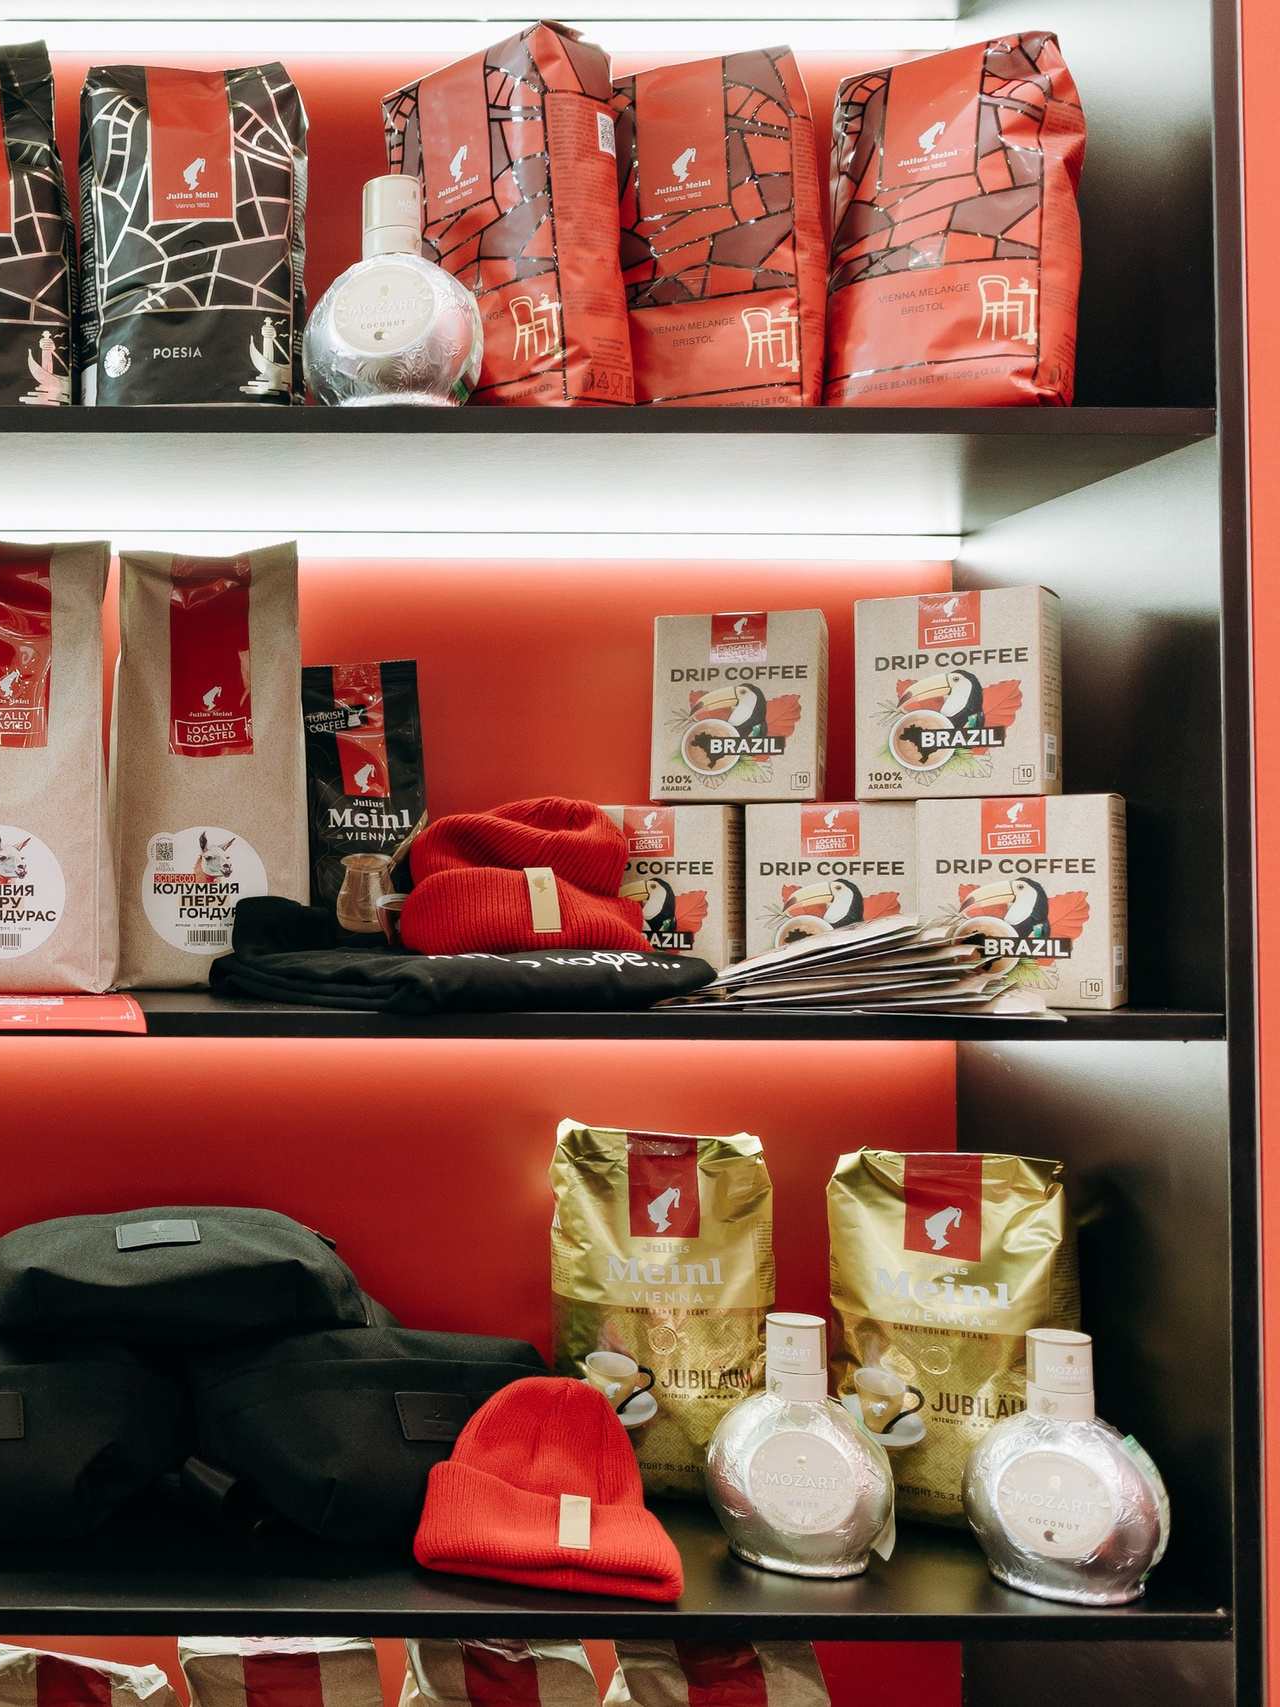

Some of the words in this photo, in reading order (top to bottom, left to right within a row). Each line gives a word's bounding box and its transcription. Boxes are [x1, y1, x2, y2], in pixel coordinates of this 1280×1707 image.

[878, 290, 916, 304] VIENNA
[918, 283, 971, 297] MELANGE
[349, 298, 418, 316] MOZART
[901, 302, 945, 316] BRISTOL
[360, 320, 406, 330] COCONUT
[650, 324, 685, 336] VIENNA
[688, 316, 736, 330] MELANGE
[672, 335, 714, 348] BRISTOL
[153, 346, 203, 361] POESIA
[858, 381, 889, 394] COFFEE
[890, 378, 918, 390] BEANS
[920, 374, 935, 385] NET
[933, 626, 966, 636] LOCALLY
[933, 631, 968, 641] ROASTED
[874, 653, 930, 672] DRIP
[934, 647, 1029, 668] COFFEE
[670, 667, 720, 683] DRIP
[724, 665, 808, 681] COFFEE
[308, 710, 345, 723] TURKISH
[186, 723, 234, 735] LOCALLY
[309, 719, 347, 733] COFFEE
[186, 730, 237, 742] ROASTED
[920, 728, 1003, 748] BRAZIL
[710, 738, 782, 754] BRAZIL
[660, 775, 692, 784] 100%
[798, 775, 808, 784] 10
[868, 771, 903, 782] 100%
[1021, 768, 1032, 778] 10
[352, 799, 385, 808] Julius
[327, 808, 412, 829] Meinl
[345, 832, 396, 841] VIENNA
[816, 837, 846, 845] LOCALLY
[997, 832, 1031, 842] LOCALLY
[997, 838, 1032, 847] ROASTED
[815, 842, 847, 851] ROASTED
[636, 861, 714, 875] COFFEE
[760, 862, 812, 876] DRIP
[816, 861, 905, 876] COFFEE
[936, 859, 993, 874] DRIP
[998, 858, 1096, 874] COFFEE
[154, 874, 195, 883] ЭСПРЕССО
[153, 883, 239, 895] КОЛУМБИЯ
[181, 895, 228, 907] ПЕРУ
[984, 938, 1069, 957] BRAZIL
[1089, 982, 1100, 992] 10
[642, 1242, 690, 1254] Julius
[604, 1255, 725, 1286] Meinl
[915, 1258, 969, 1276] Julius
[873, 1267, 1012, 1310] Meinl
[631, 1290, 703, 1304] VIENNA
[625, 1307, 649, 1315] GANZE
[652, 1307, 677, 1316] BOHNE
[686, 1308, 709, 1316] BEANS
[901, 1306, 983, 1327] VIENNA
[893, 1324, 919, 1333] GANZE
[922, 1327, 951, 1337] BOHNE
[961, 1332, 989, 1341] BEANS
[770, 1344, 812, 1358] MOZART
[1046, 1364, 1090, 1376] MOZART
[661, 1365, 753, 1390] JUBILÄUM
[931, 1392, 1025, 1419] JUBILÄU
[664, 1463, 683, 1472] 35.3
[684, 1464, 695, 1473] OZ
[764, 1472, 839, 1490] MOZART
[896, 1483, 932, 1498] WEIGHT
[934, 1490, 955, 1501] 35.3
[786, 1500, 820, 1509] WHITE
[1014, 1490, 1094, 1514] MOZART
[1028, 1516, 1080, 1532] COCONUT
